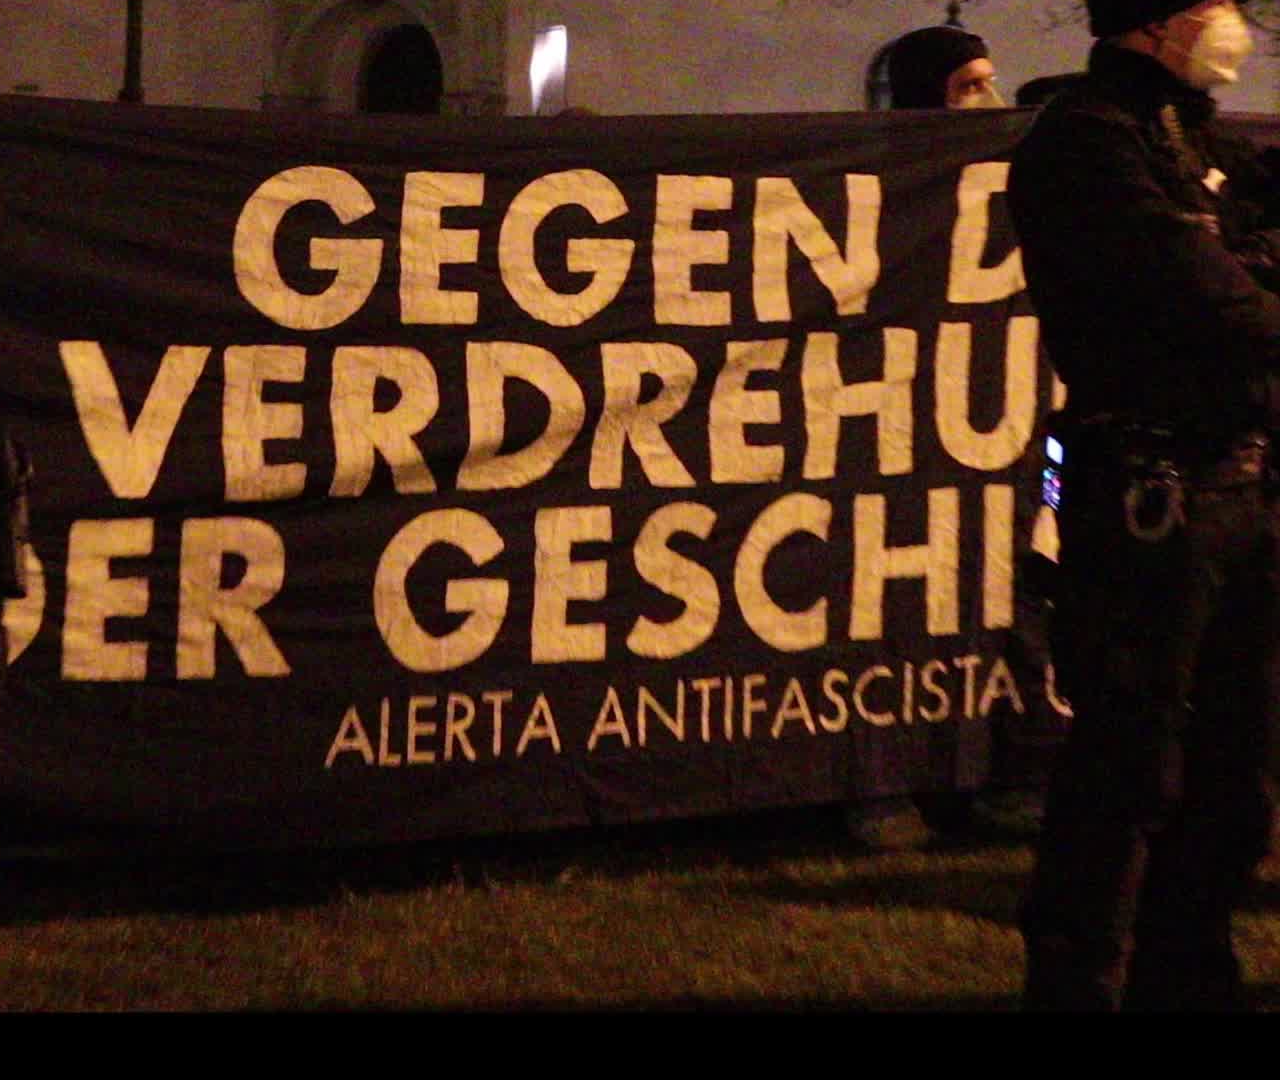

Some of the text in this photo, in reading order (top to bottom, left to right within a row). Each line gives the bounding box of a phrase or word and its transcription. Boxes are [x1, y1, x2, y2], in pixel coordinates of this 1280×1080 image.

[232, 165, 881, 330] GEGEN
[58, 315, 1069, 502] VERDREHU
[322, 688, 562, 768] ALERTA
[587, 653, 1025, 752] ANTIFASCISTA
